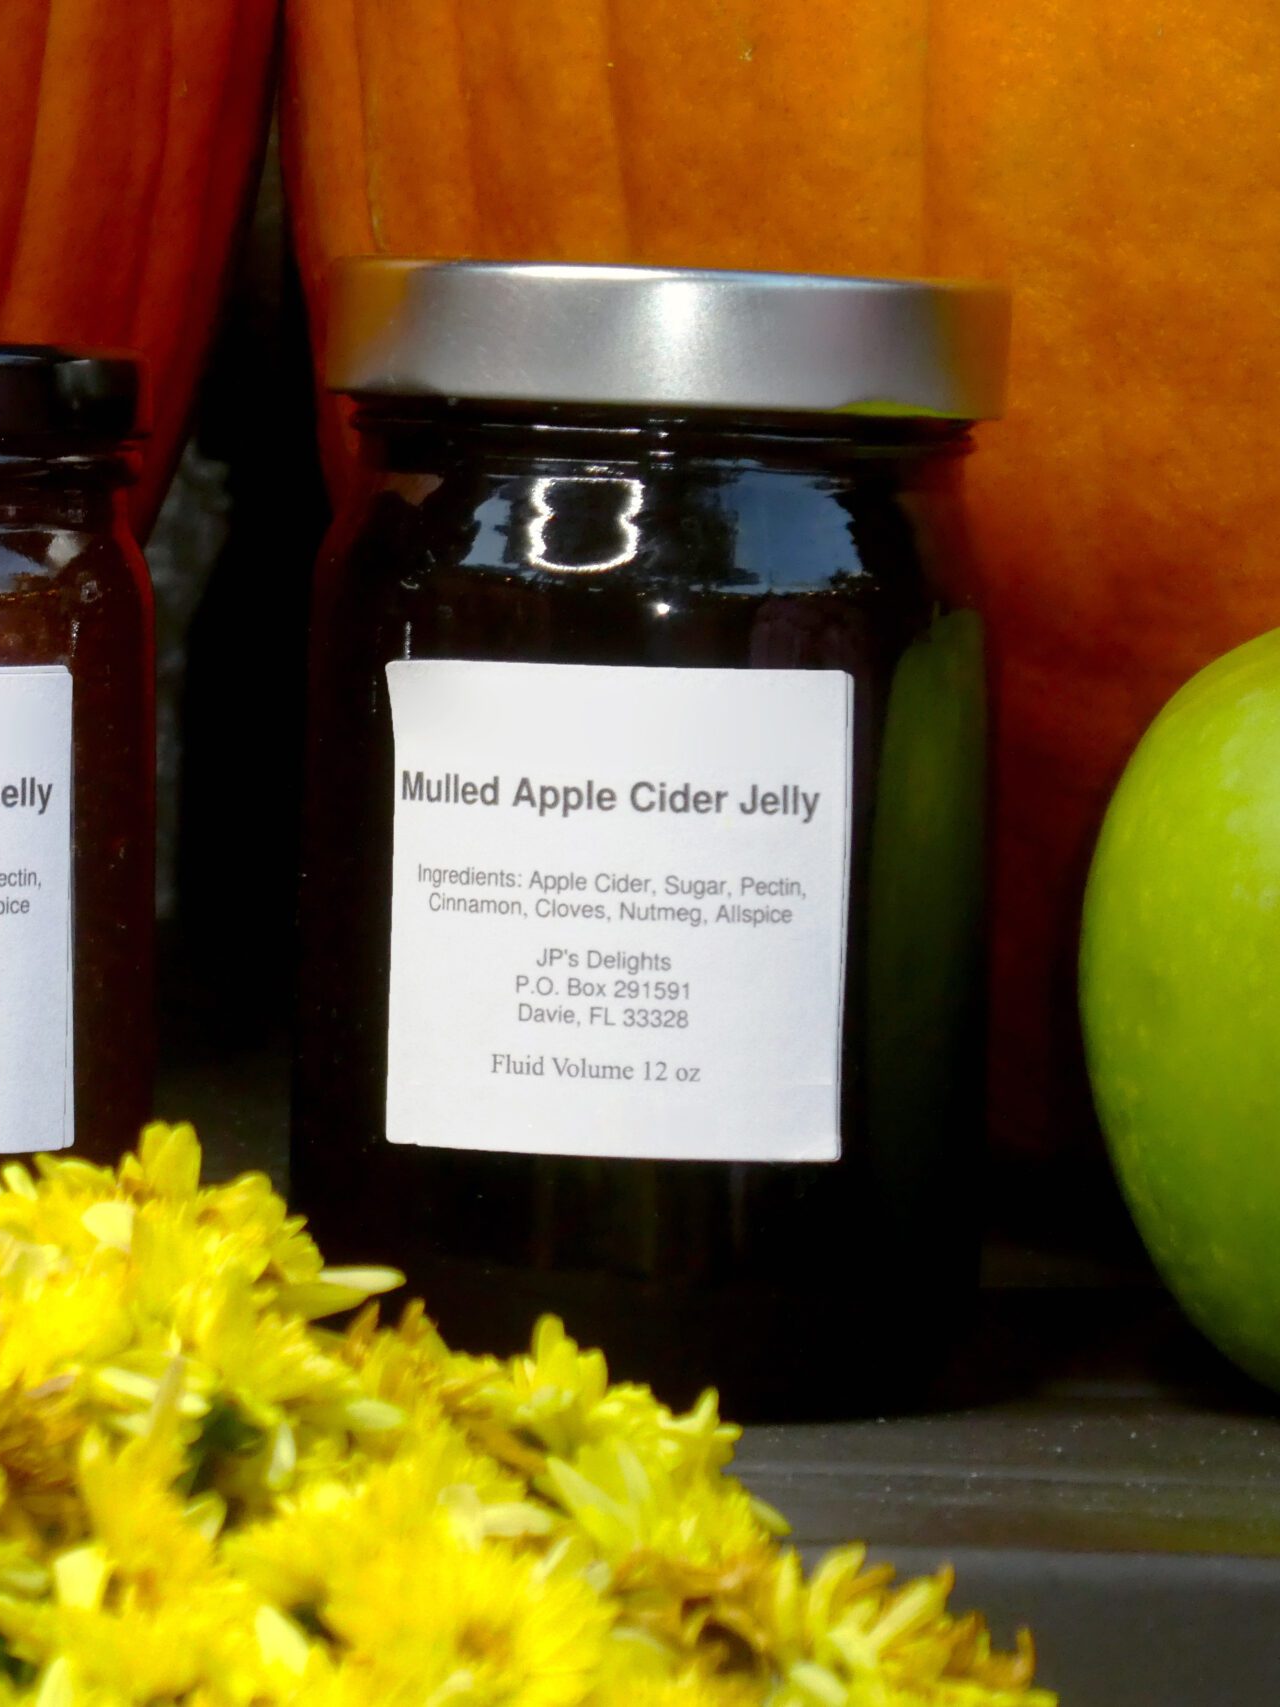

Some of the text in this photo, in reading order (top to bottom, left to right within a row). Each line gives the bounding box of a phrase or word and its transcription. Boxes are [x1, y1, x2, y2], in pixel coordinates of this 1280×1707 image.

[401, 769, 821, 825] Mulled Apple Cider Jelly
[417, 863, 807, 901] Ingredients: Apple Cider, Sugar, Pectin,
[428, 891, 794, 928] Cinnamon, Cloves, Nutmeg, Allspice
[535, 947, 672, 976] JP's Delights
[515, 974, 691, 1001] P.O. Box 291591
[518, 1002, 689, 1029] Davie, FL 33328
[490, 1053, 701, 1083] Fluid Volume 12 oz
